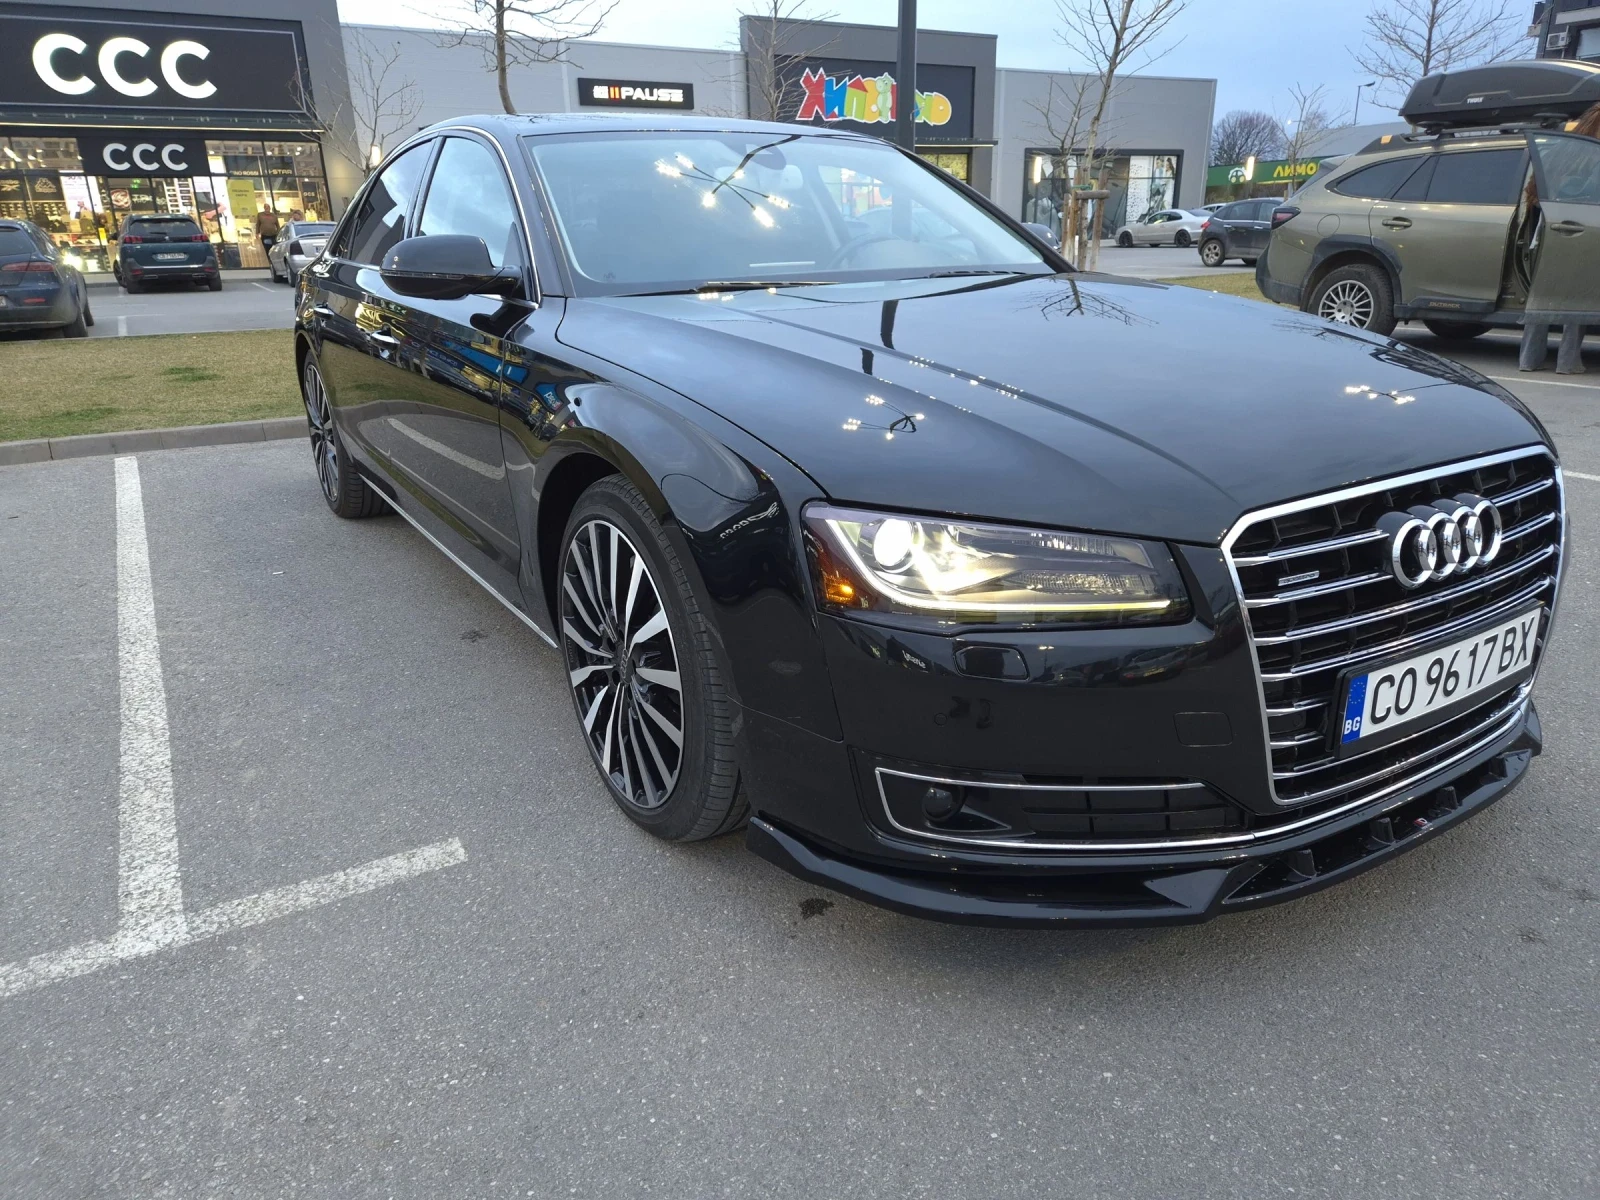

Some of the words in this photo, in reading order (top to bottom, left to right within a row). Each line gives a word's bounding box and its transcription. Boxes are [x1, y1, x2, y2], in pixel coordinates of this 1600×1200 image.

[32, 33, 218, 99] CCC
[620, 86, 684, 103] PAUSE
[102, 143, 189, 171] CCC
[1370, 667, 1417, 725] CO
[1425, 633, 1499, 707] 9617
[1497, 615, 1535, 675] BX
[1344, 716, 1362, 736] BG
